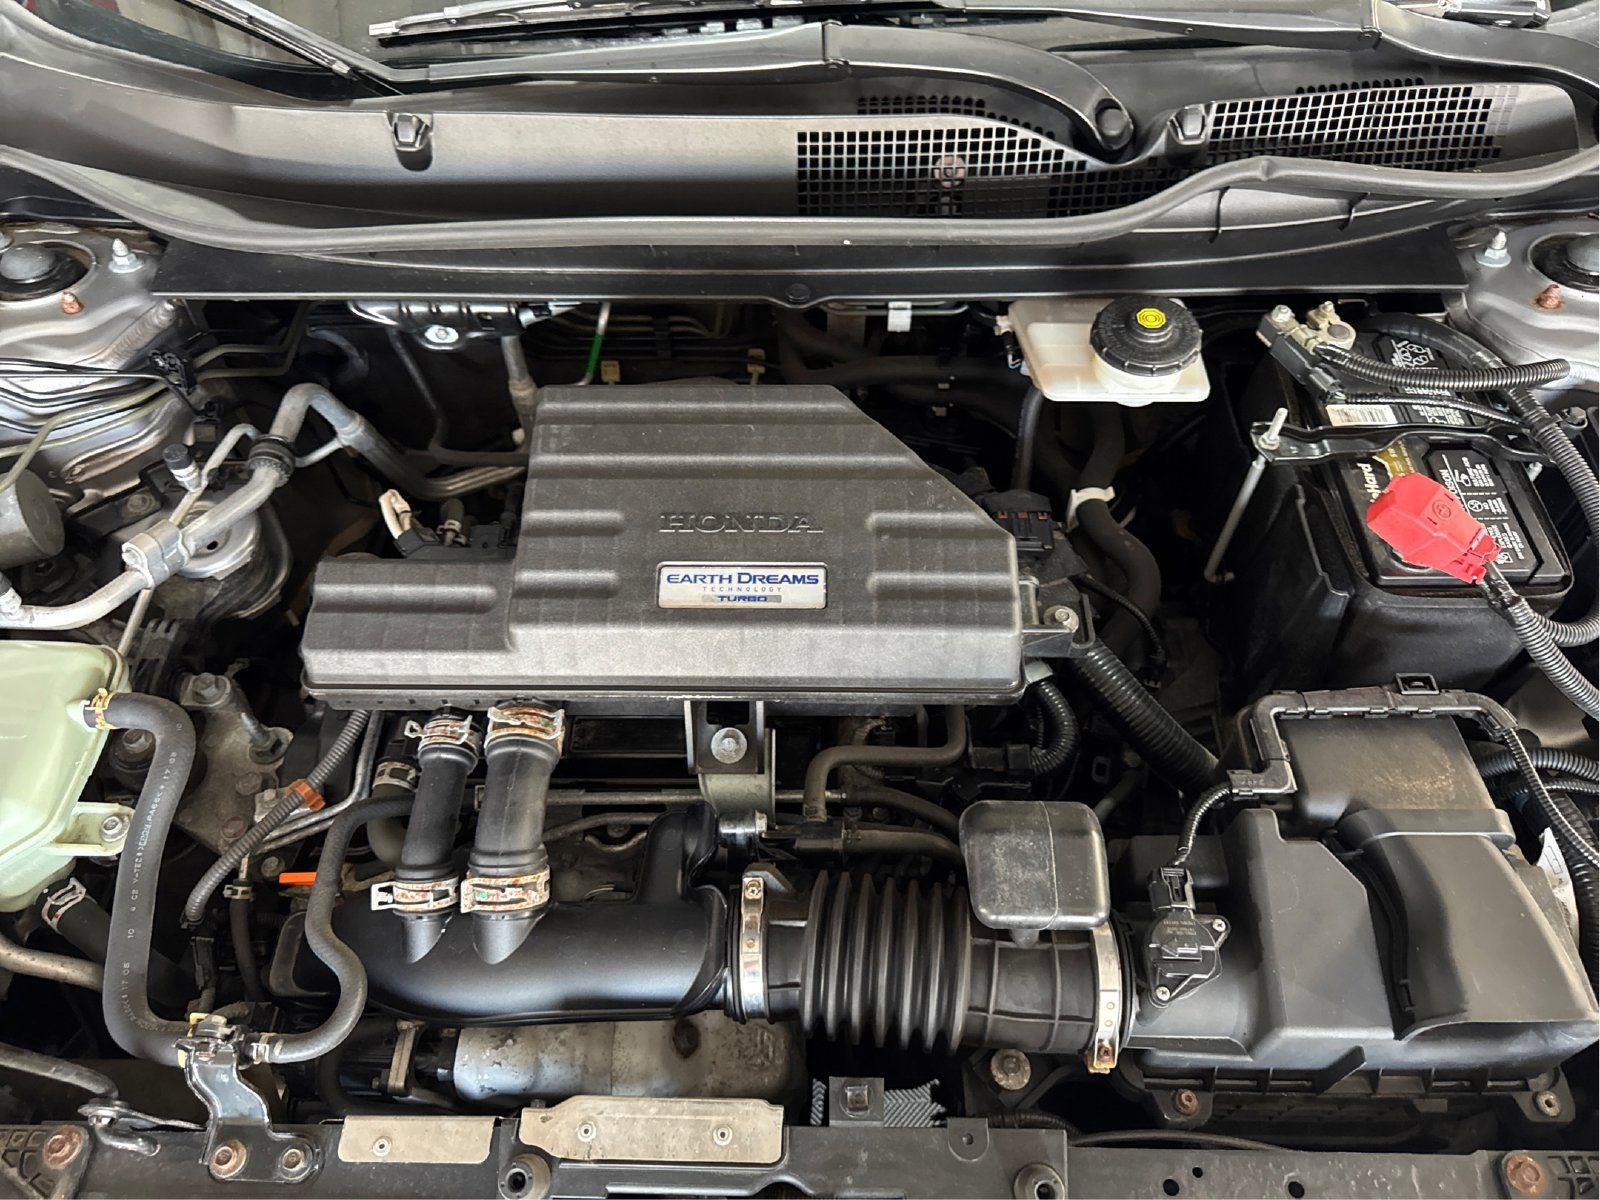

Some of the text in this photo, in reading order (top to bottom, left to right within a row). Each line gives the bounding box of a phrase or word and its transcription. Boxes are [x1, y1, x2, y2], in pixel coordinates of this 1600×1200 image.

[659, 512, 824, 533] HONDA
[666, 572, 819, 584] EARTH DREAMS
[127, 928, 136, 940] 10
